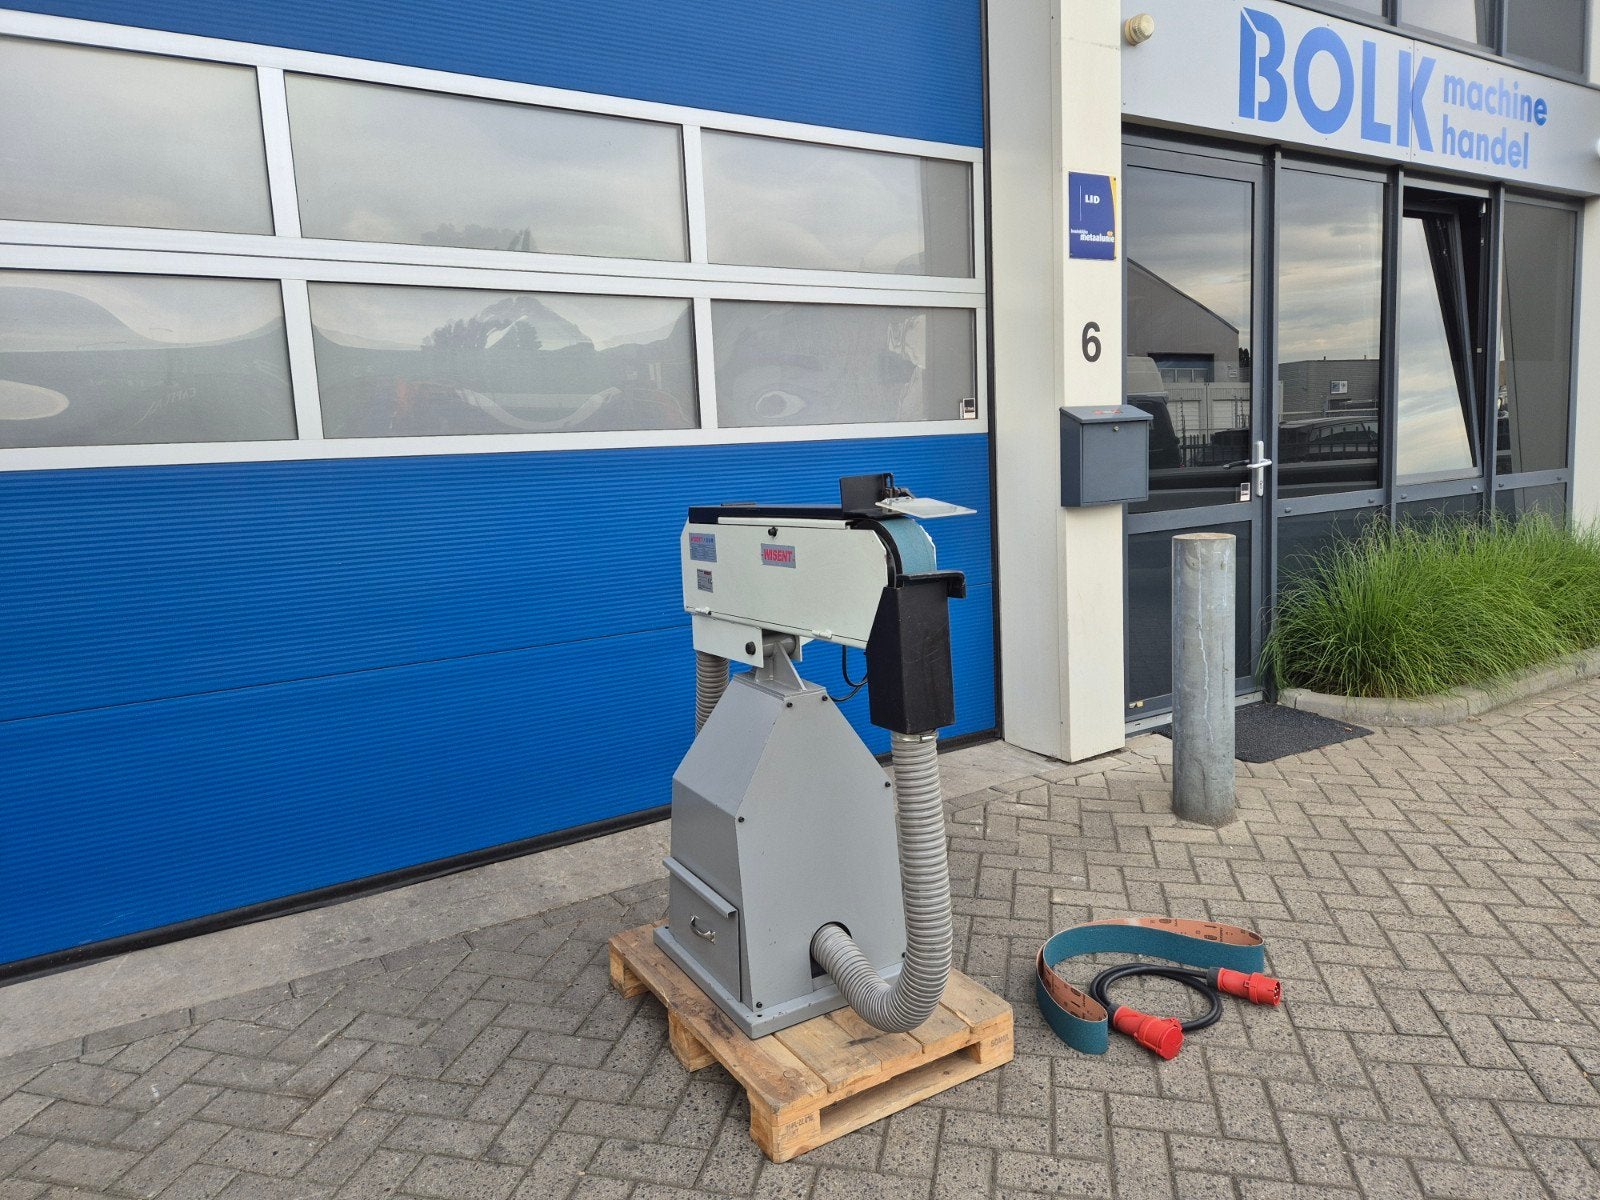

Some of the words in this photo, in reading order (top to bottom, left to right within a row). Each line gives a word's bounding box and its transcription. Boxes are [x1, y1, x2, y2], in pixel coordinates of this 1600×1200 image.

[1238, 7, 1436, 152] BOLK
[1443, 73, 1548, 126] machine
[1442, 115, 1529, 169] handel
[1085, 194, 1100, 204] LID
[1081, 321, 1102, 362] 6
[763, 548, 793, 563] WISENT
